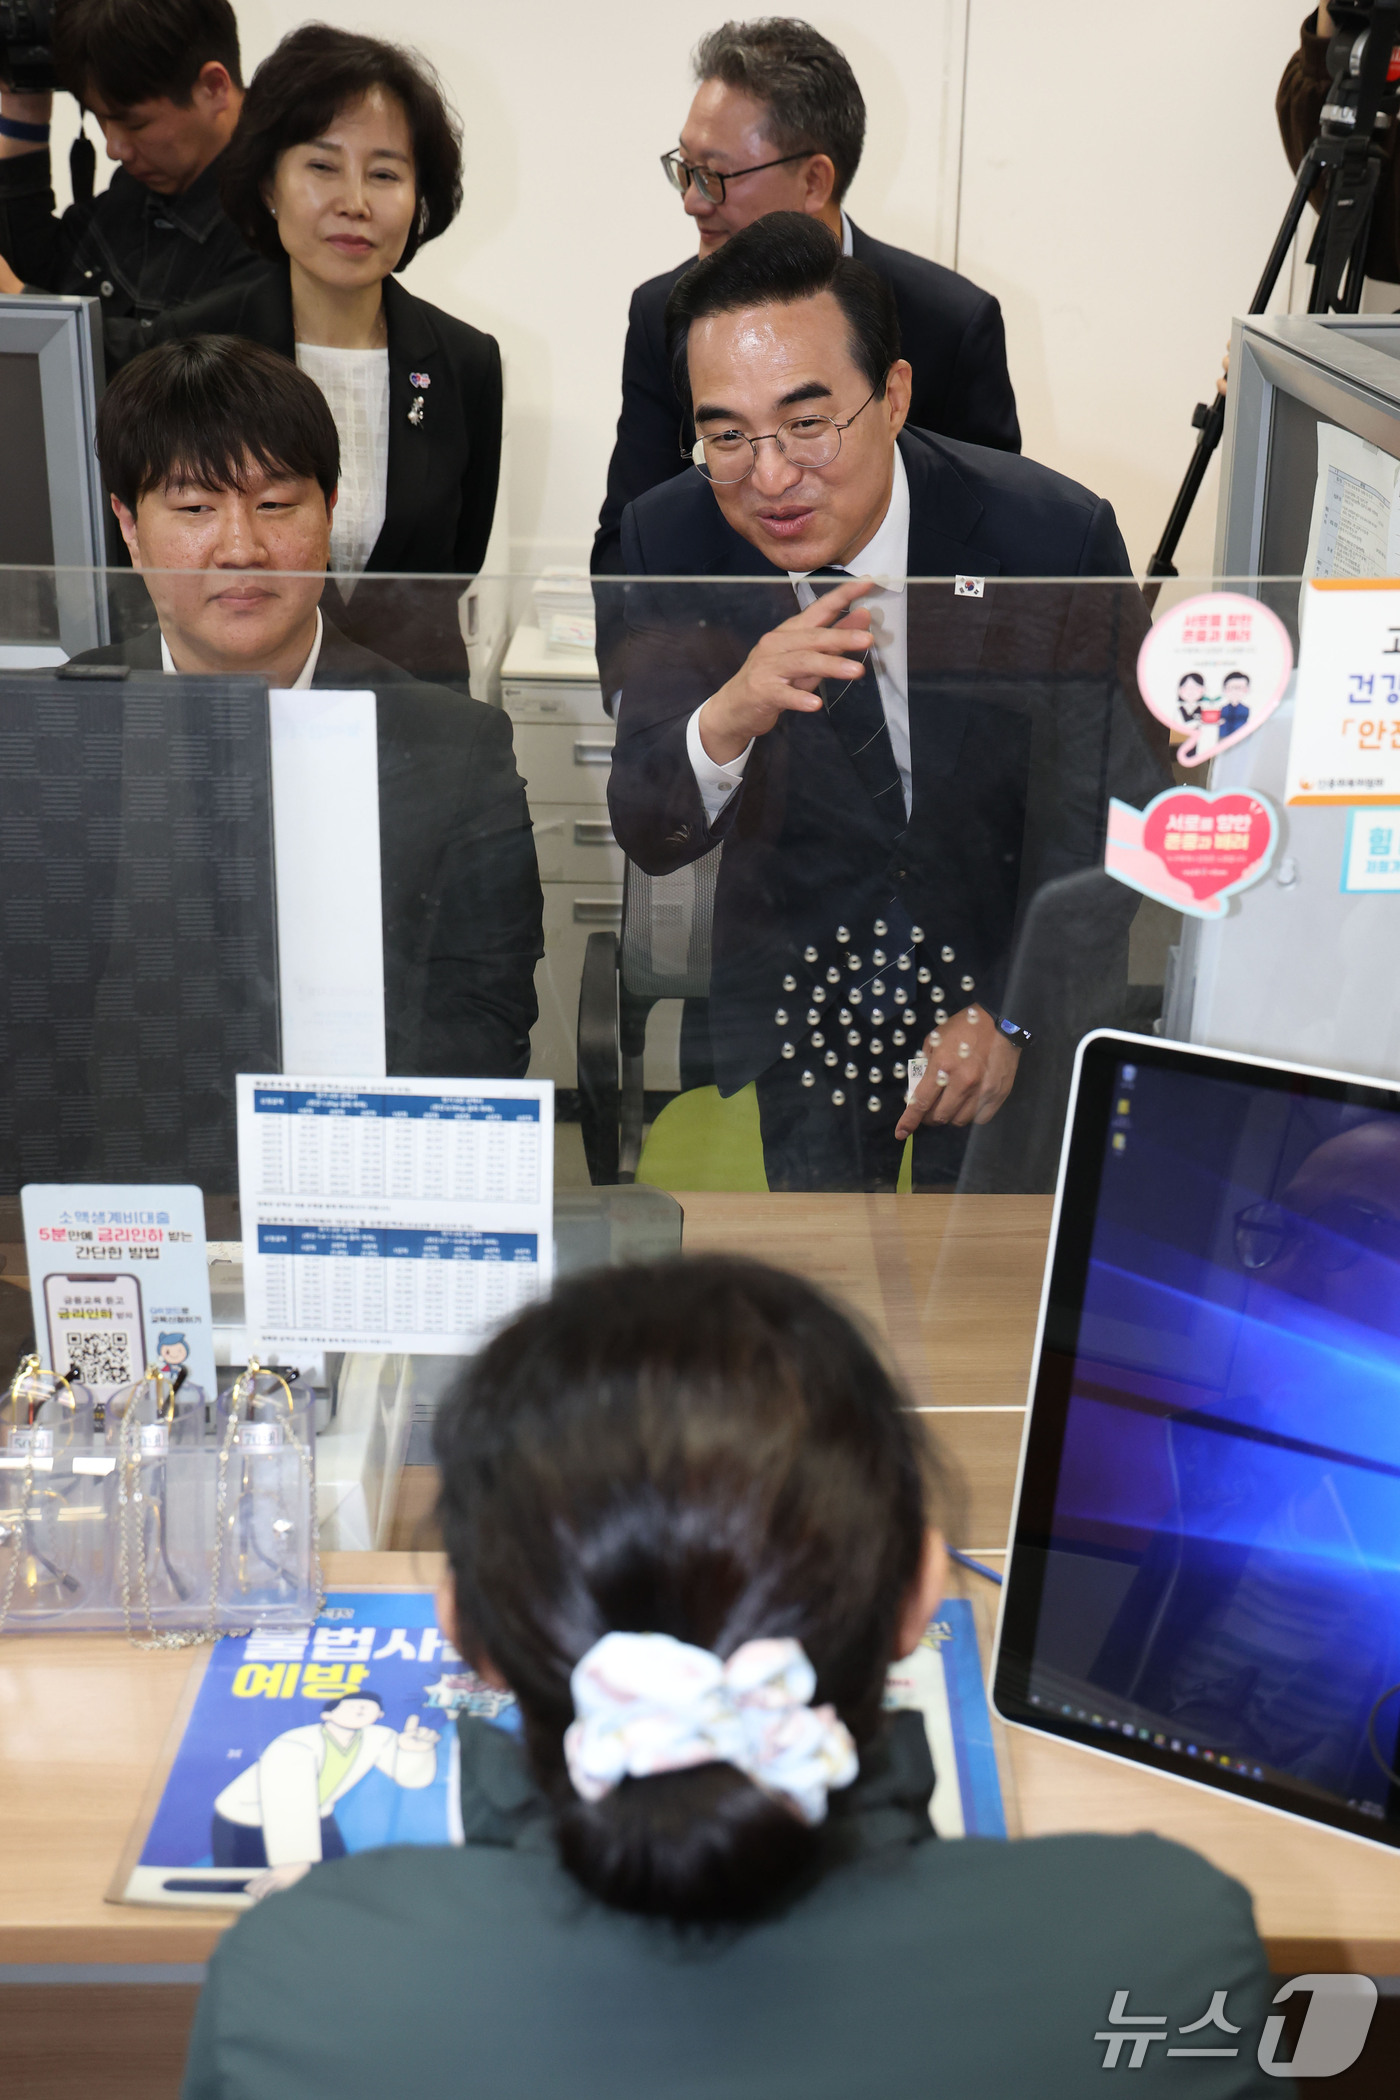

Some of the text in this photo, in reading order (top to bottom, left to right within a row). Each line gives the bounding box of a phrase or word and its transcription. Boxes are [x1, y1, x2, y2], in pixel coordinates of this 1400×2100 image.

[59, 1211, 171, 1225] 소액생계비대출
[39, 1227, 193, 1243] 5분만에 금리인하 받는
[75, 1246, 160, 1260] 간단한 방법
[57, 1307, 113, 1321] 금리인하
[231, 1662, 371, 1700] 예방
